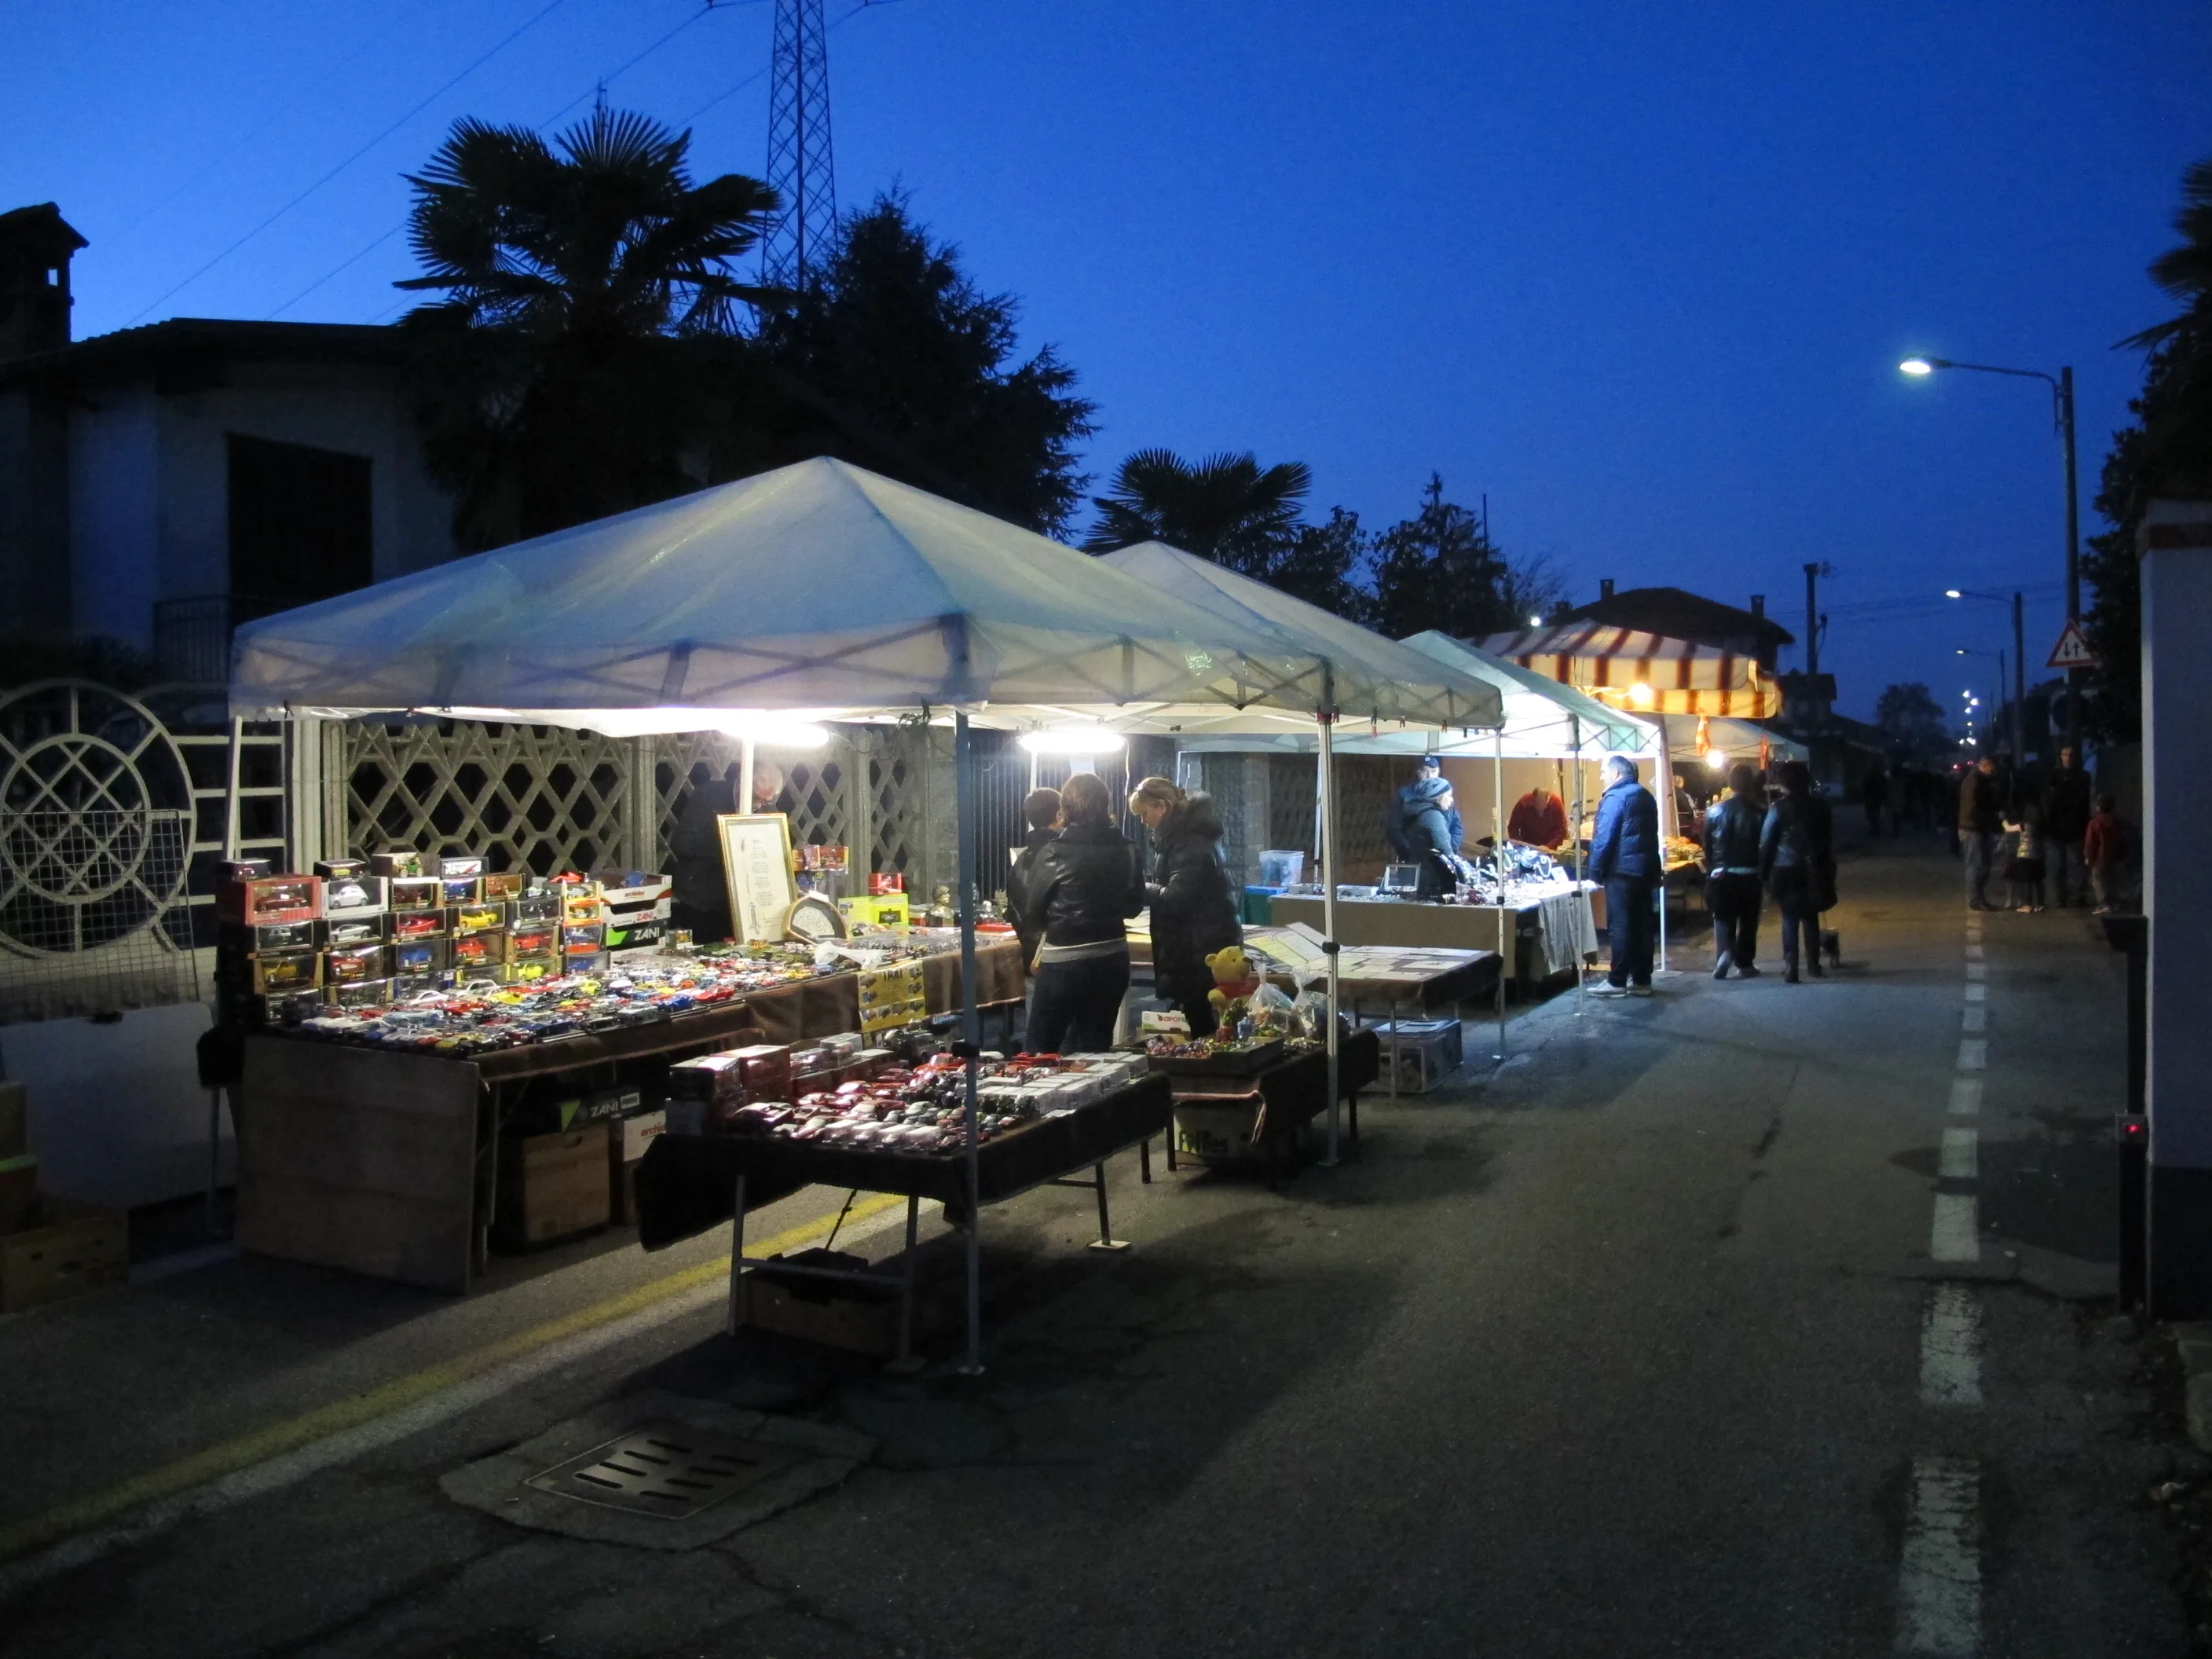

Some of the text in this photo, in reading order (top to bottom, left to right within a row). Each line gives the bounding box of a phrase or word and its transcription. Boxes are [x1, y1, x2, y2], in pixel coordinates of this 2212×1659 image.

[636, 912, 654, 921] ZANI
[635, 927, 660, 941] ZANI
[591, 1101, 618, 1118] ZANI
